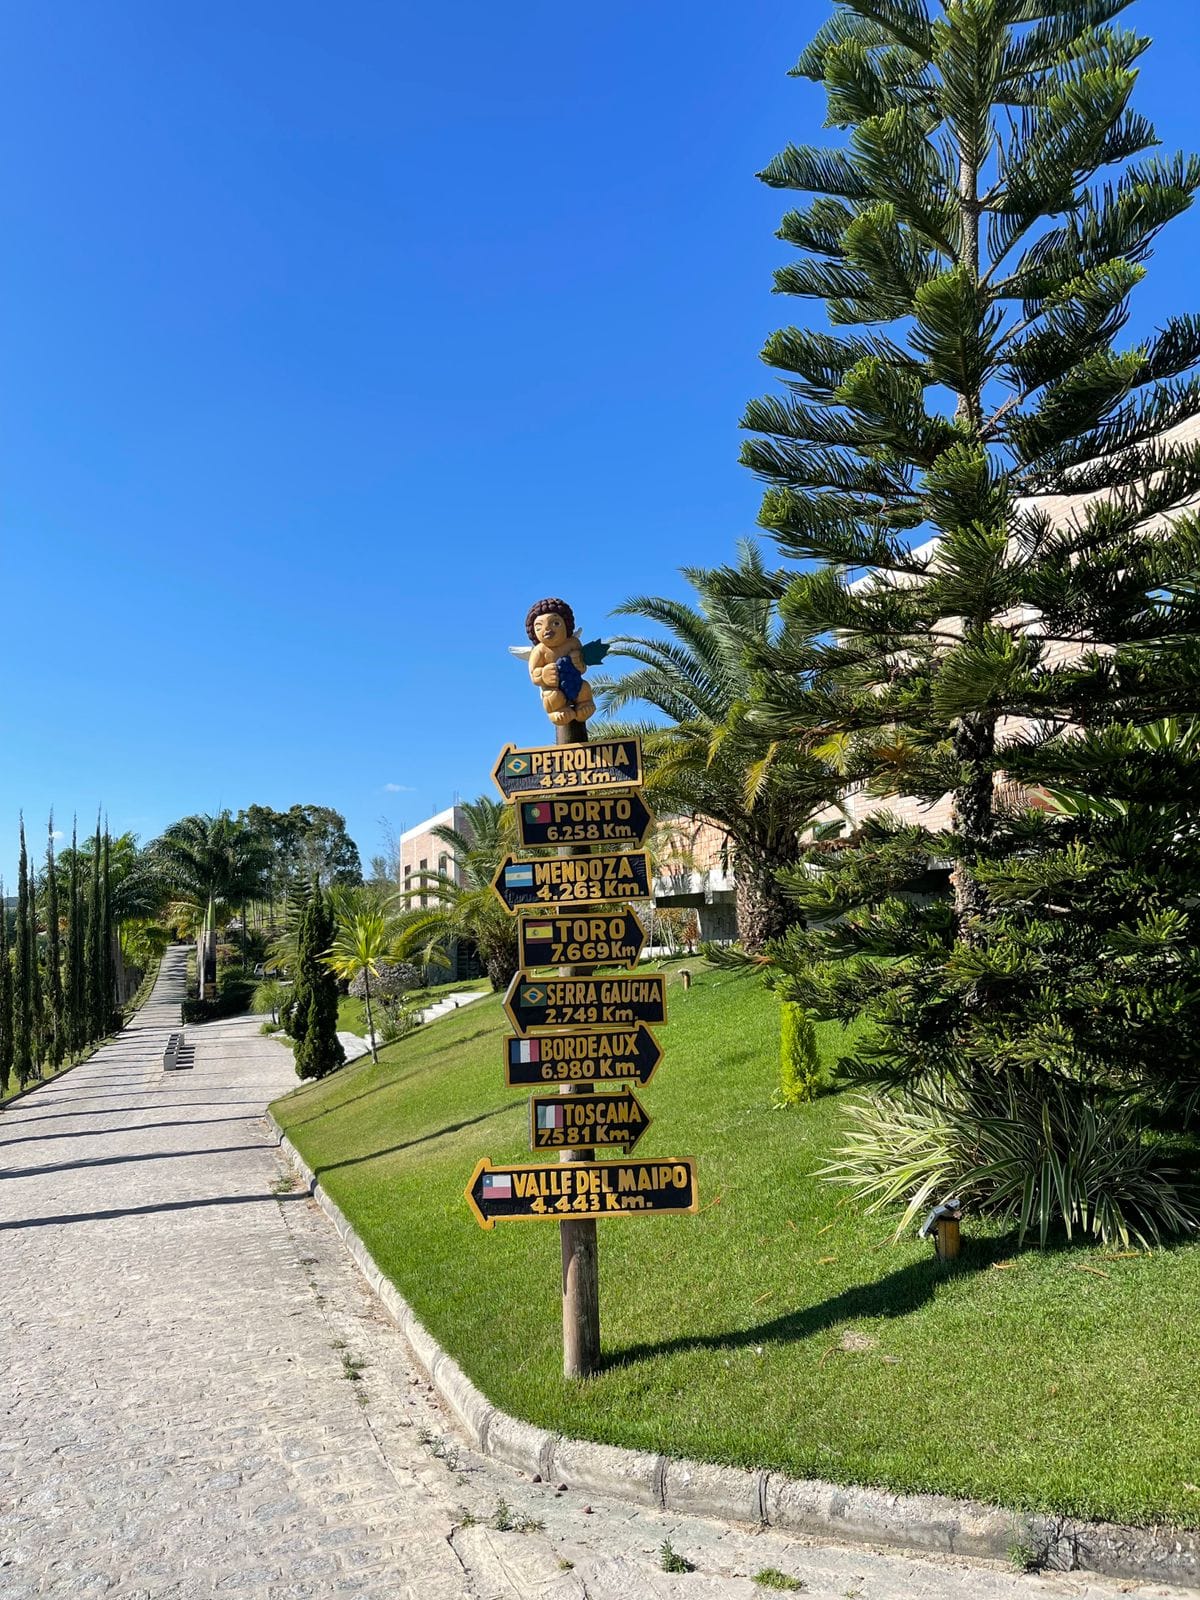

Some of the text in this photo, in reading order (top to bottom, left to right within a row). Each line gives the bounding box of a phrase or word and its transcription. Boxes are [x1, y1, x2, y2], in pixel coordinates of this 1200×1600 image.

[531, 745, 630, 774] PETROLINA
[539, 772, 578, 788] 443
[554, 800, 631, 823] PORTO
[547, 823, 637, 840] 6.258 Km.
[534, 857, 633, 886] MENDOZA
[536, 882, 601, 901] 4.263
[604, 880, 644, 896] Km.
[555, 918, 626, 943] TORO
[551, 943, 609, 962] 7.669
[546, 982, 598, 1006] SERRA
[545, 1007, 598, 1024] 2.749
[541, 1033, 640, 1062] BORDEAUX
[541, 1059, 641, 1079] 6.980 Km.
[564, 1101, 642, 1126] TOSCANA
[596, 1125, 635, 1142] Km.
[512, 1166, 688, 1198] VALLE DEL MAIPO
[530, 1193, 653, 1215] 4.443 Km.
